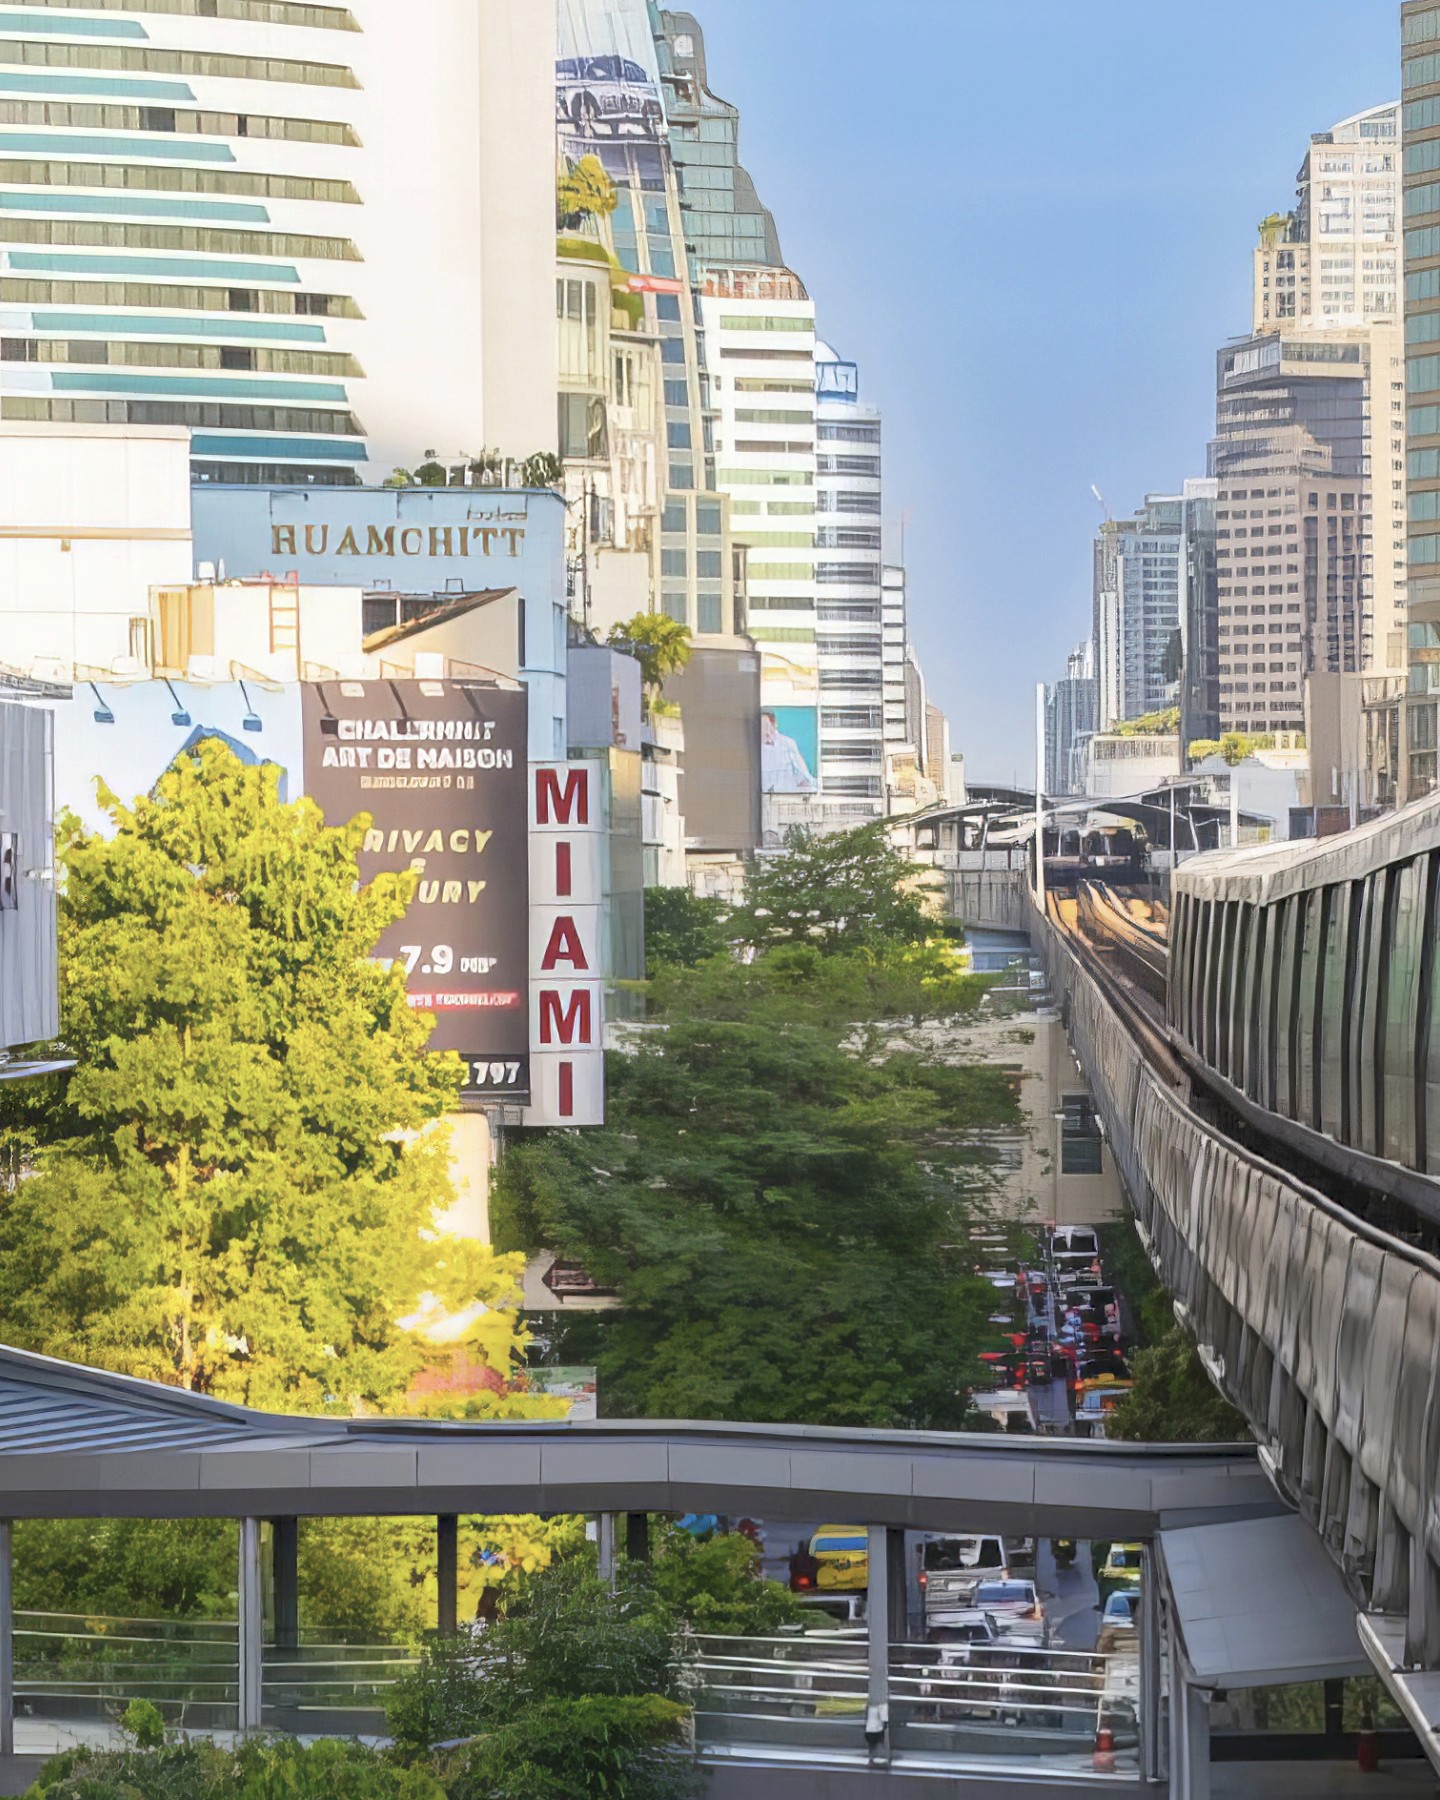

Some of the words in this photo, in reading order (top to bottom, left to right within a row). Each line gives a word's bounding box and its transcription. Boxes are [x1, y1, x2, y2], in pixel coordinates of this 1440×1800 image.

[270, 523, 526, 557] RUAMCHITT
[322, 747, 373, 768] ART
[416, 748, 513, 769] MAISON
[362, 829, 494, 853] RIVACY
[535, 768, 592, 1117] MIAMI
[399, 944, 454, 975] 7.9
[464, 1061, 521, 1086] 797
